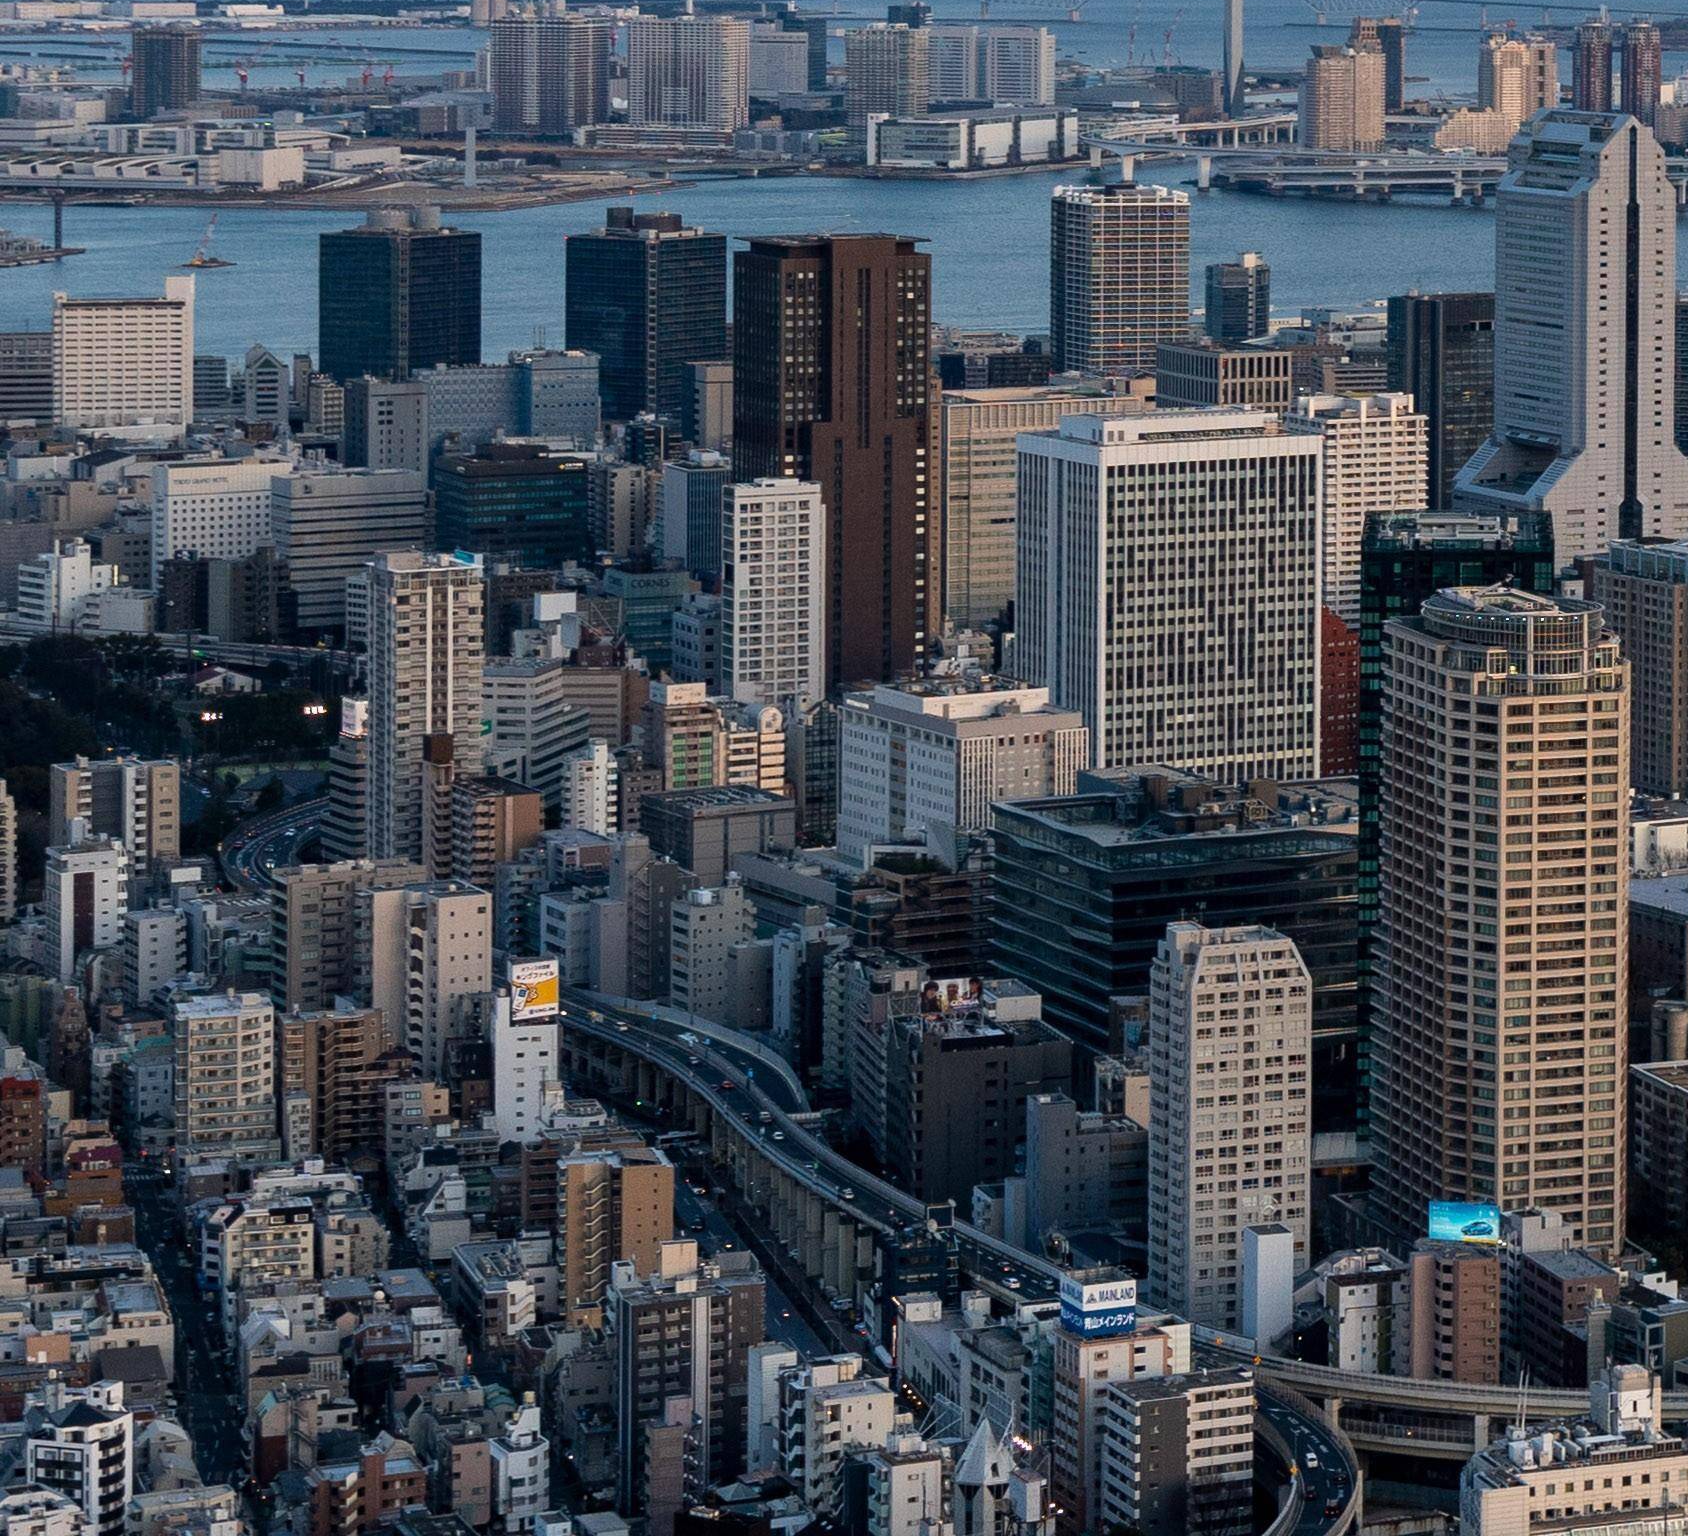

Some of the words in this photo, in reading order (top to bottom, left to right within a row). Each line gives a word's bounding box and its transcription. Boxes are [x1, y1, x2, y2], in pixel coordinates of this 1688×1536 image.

[631, 578, 671, 589] CORNES
[516, 970, 554, 981] キングファイル
[1098, 1287, 1134, 1302] MAINLAND
[1084, 1313, 1135, 1331] 青山メインランド
